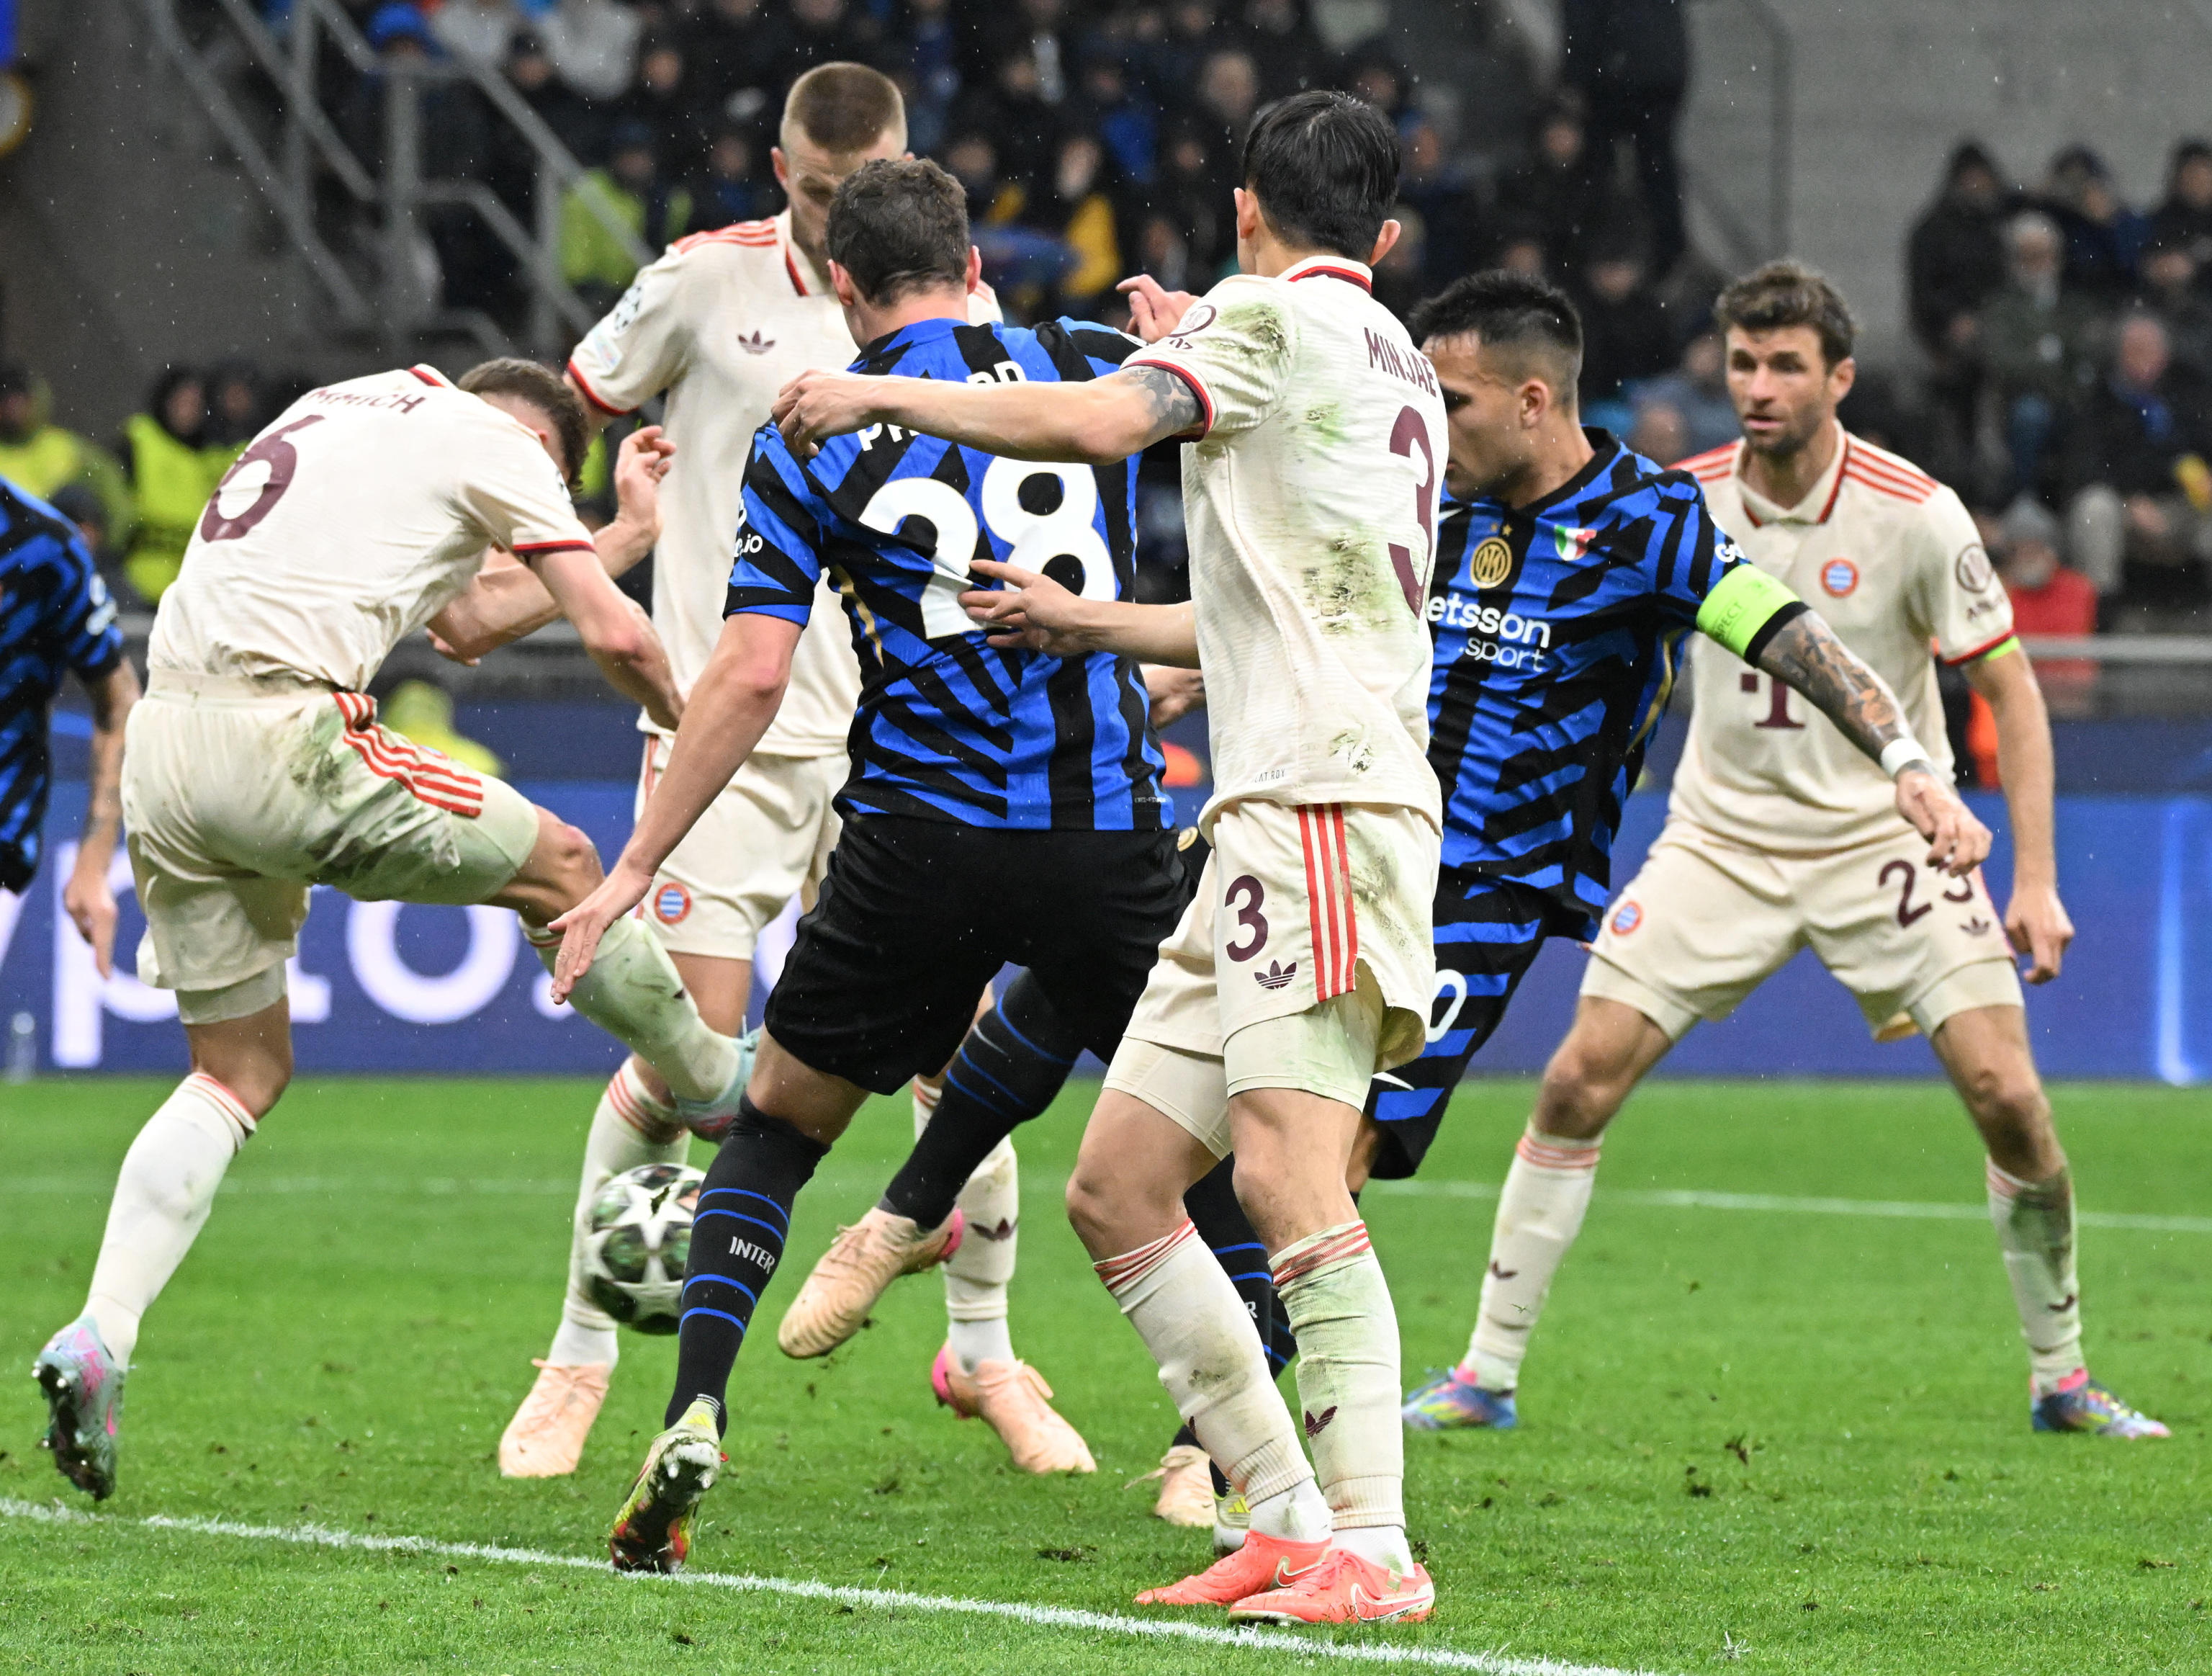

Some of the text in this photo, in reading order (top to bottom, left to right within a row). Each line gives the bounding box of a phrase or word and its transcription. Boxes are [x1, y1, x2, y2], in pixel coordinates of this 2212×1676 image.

[1364, 326, 1437, 398] MINJAE
[201, 414, 325, 543] 6
[1388, 405, 1434, 620] 3
[858, 455, 1116, 640] 28
[1426, 592, 1551, 648] etsson
[1225, 874, 1269, 962] 3
[1425, 969, 1467, 1044] 0
[729, 1236, 775, 1274] INTER
